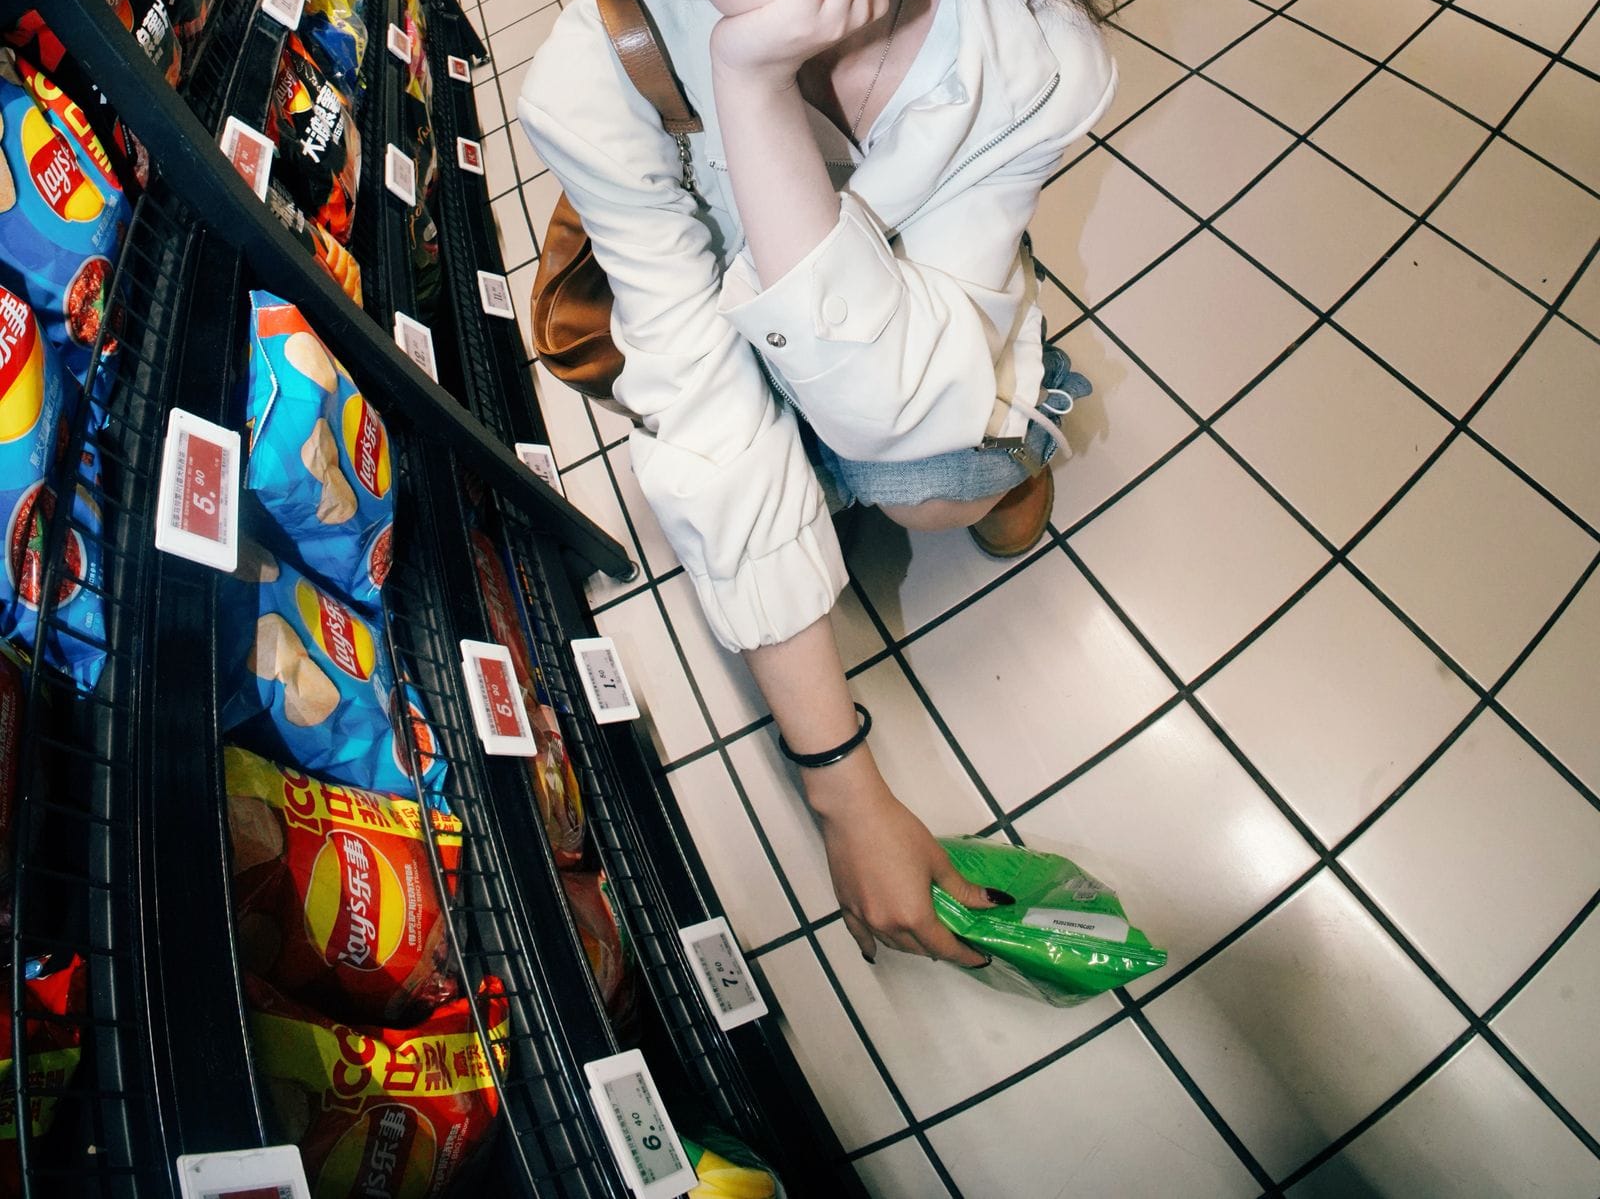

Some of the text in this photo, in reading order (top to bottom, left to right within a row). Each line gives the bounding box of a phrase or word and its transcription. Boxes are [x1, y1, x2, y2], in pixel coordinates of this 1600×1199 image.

[192, 469, 216, 516] 5.90
[338, 834, 376, 966] Lay's乐事
[714, 960, 739, 988] 7.50
[631, 1111, 662, 1151] 6.40
